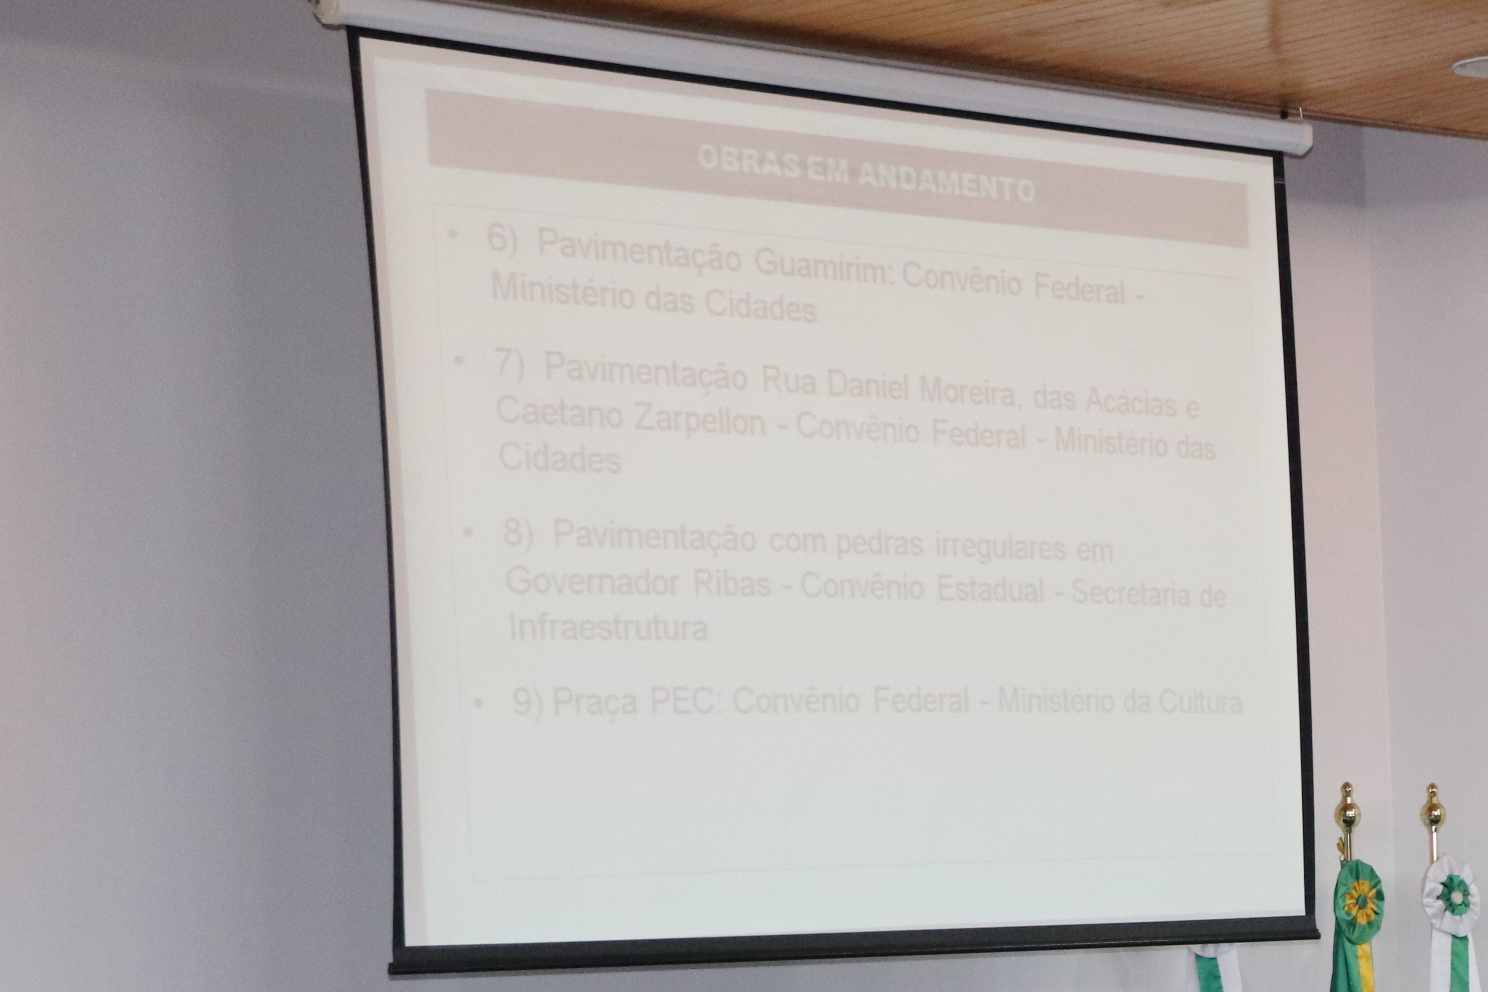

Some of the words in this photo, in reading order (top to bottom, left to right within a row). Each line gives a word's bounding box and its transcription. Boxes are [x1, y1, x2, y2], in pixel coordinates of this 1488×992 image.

[697, 143, 801, 178] OBRAS
[807, 154, 849, 184] EM
[859, 161, 1036, 204] ANDAMENTO
[486, 222, 518, 258] 6)
[537, 225, 742, 276] Pavimentação
[754, 246, 895, 286] Guamirim:
[902, 260, 1022, 298] Convênio
[1034, 271, 1126, 305] Federal
[490, 270, 635, 311] Ministério
[645, 284, 695, 314] das
[704, 289, 818, 324] Cidades
[494, 346, 525, 384] 7)
[544, 350, 748, 396] Pavimentação
[762, 365, 817, 395] Rua
[827, 369, 909, 401] Daniel
[920, 374, 1023, 410] Moreira,
[1033, 384, 1077, 410] das
[1086, 386, 1178, 418] Acácias
[1186, 400, 1201, 419] e
[496, 394, 623, 429] Caetano
[634, 401, 766, 438] Zarpellon
[795, 411, 921, 443] Convênio
[932, 418, 1026, 450] Federal
[1055, 425, 1169, 459] Ministério
[1177, 435, 1217, 461] das
[499, 441, 622, 474] Cidades
[503, 517, 534, 553] 8)
[554, 518, 757, 558] Pavimentação
[769, 530, 827, 554] com
[836, 532, 924, 561] pedras
[935, 531, 1067, 564] irregulares
[1076, 539, 1114, 562] em
[505, 565, 680, 596] Governador
[694, 568, 771, 598] Ribas
[802, 570, 925, 601] Convênio
[937, 574, 1045, 603] Estadual
[1071, 578, 1191, 608] Secretaria
[1200, 584, 1227, 608] de
[510, 612, 709, 642] Infraestrutura
[512, 687, 544, 722] 9)
[554, 686, 638, 724] Praça
[650, 686, 723, 715] PEC:
[732, 686, 860, 714] Convênio
[873, 685, 970, 714] Federal
[998, 686, 1115, 714] Ministério
[1123, 687, 1152, 714] da
[1158, 688, 1243, 715] Cultura
